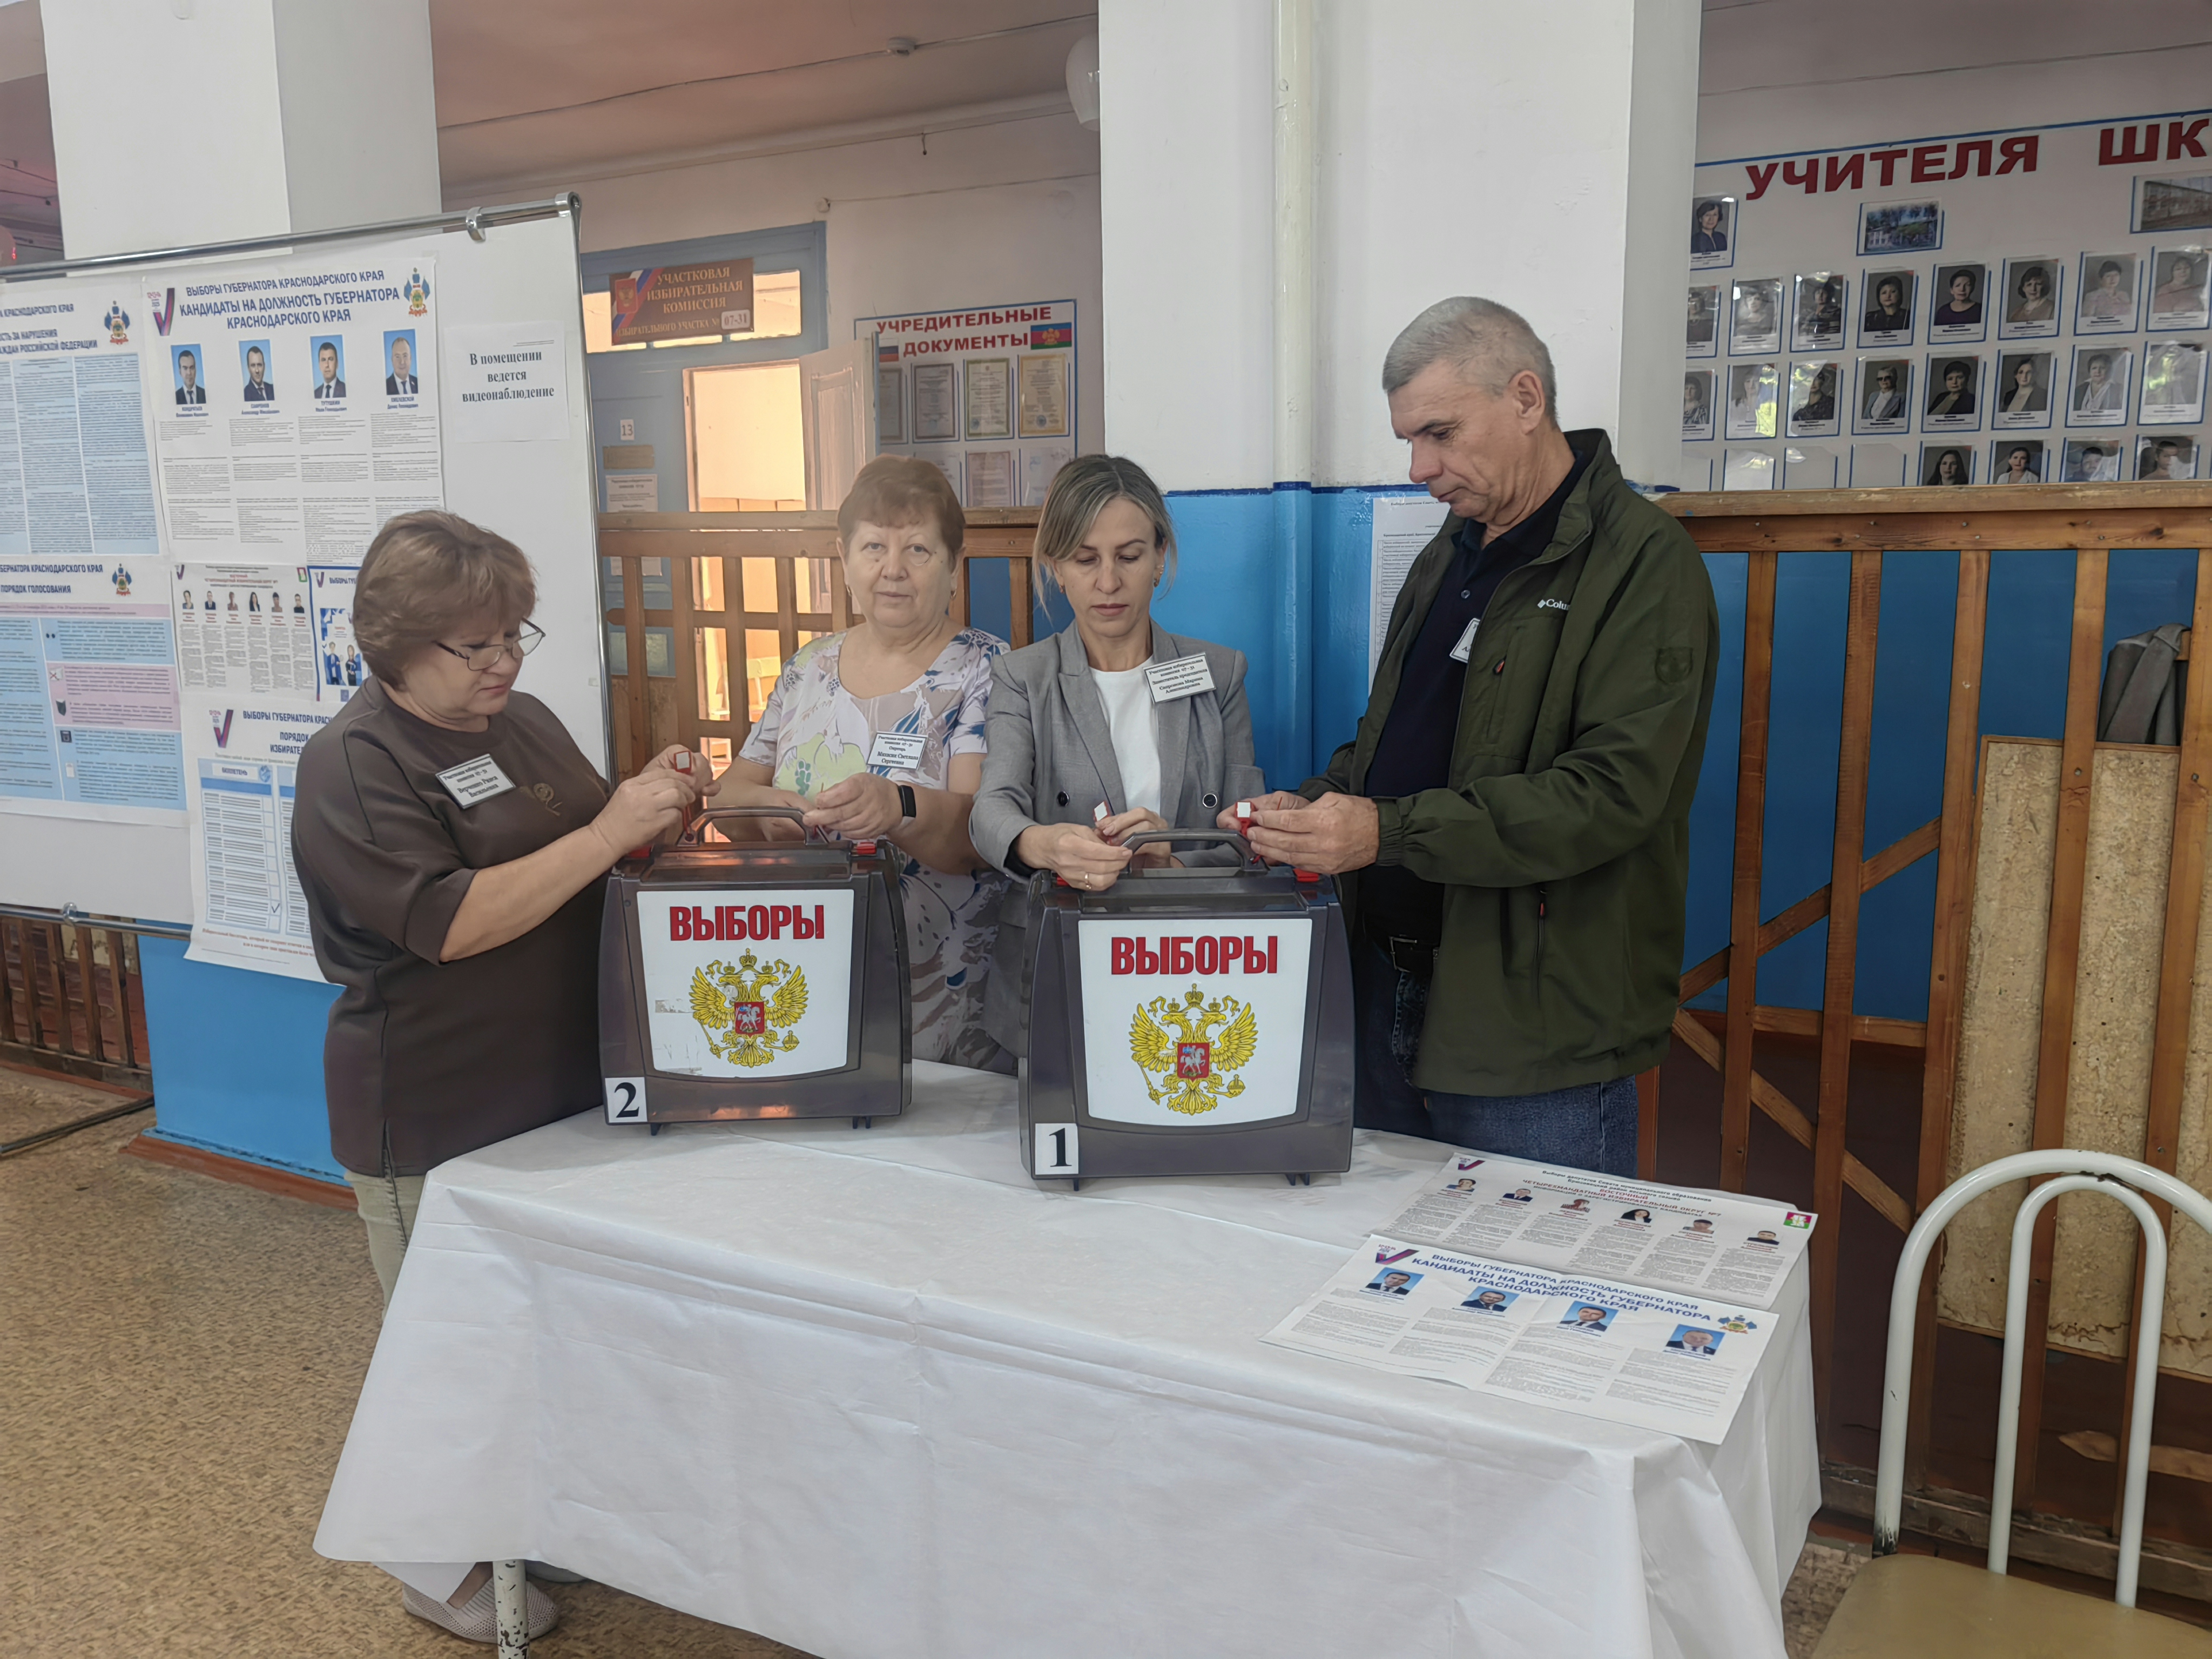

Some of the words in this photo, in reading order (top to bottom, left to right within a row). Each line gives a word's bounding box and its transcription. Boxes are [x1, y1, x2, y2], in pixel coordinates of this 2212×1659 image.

[1745, 134, 2040, 200] УЧИТЕЛЯ
[186, 284, 222, 296] ВЫБОРЫ
[223, 280, 277, 293] ГУБЕРНАТОРА
[279, 273, 358, 288] КРАСНОДАРСКОГО
[359, 270, 385, 282] КРАЯ
[657, 267, 730, 285] УЧАСТКОВАЯ
[647, 280, 743, 301] ИЗБИРАТЕЛЬНАЯ
[179, 300, 241, 317] КАНДИДАТЫ
[242, 299, 257, 312] НА
[259, 294, 322, 313] ДОЛЖНОСТЬ
[323, 287, 400, 306] ГУБЕРНАТОРА
[664, 297, 726, 314] КОМИССИЯ
[227, 311, 320, 329] КРАСНОДАРСКОГО
[322, 308, 352, 323] КРАЯ
[678, 320, 710, 331] УЧАСТКА
[724, 313, 747, 326] 07-31
[876, 306, 1052, 334] УЧРЕДИТЕЛЬНЫЕ
[903, 333, 1029, 358] ДОКУМЕНТЫ
[469, 353, 477, 366] В
[481, 352, 542, 365] помещении
[488, 371, 527, 383] ведется
[462, 387, 555, 402] видеонаблюдение
[622, 424, 633, 436] 13
[87, 564, 103, 572] КРАЯ
[1, 585, 27, 593] ПОРЯДОК
[28, 585, 71, 594] ГОЛОСОВАНИЯ
[243, 711, 271, 720] ВЫБОРЫ
[272, 712, 314, 723] ГУБЕРНАТОРА
[280, 732, 309, 743] ПОРЯДОК
[669, 905, 825, 941] ВЫБОРЫ
[1111, 935, 1278, 975] ВЫБОРЫ
[613, 1082, 640, 1118] 2
[1049, 1127, 1073, 1168] 1
[1412, 1258, 1495, 1279] КАНДИДАТЫ
[1498, 1275, 1516, 1284] НА
[1518, 1279, 1606, 1298] ДОЛЖНОСТЬ
[1610, 1294, 1711, 1321] ГУБЕРНАТОРА
[1432, 1255, 1481, 1268] ВЫБОРЫ
[1483, 1265, 1556, 1284] ГУБЕРНАТОРА
[1560, 1279, 1664, 1303] КРАСНОДАРСКОГО
[1667, 1300, 1699, 1310] КРАЯ
[1468, 1277, 1596, 1302] КРАСНОДАРСКОГО
[1600, 1299, 1639, 1312] КРАЯ
